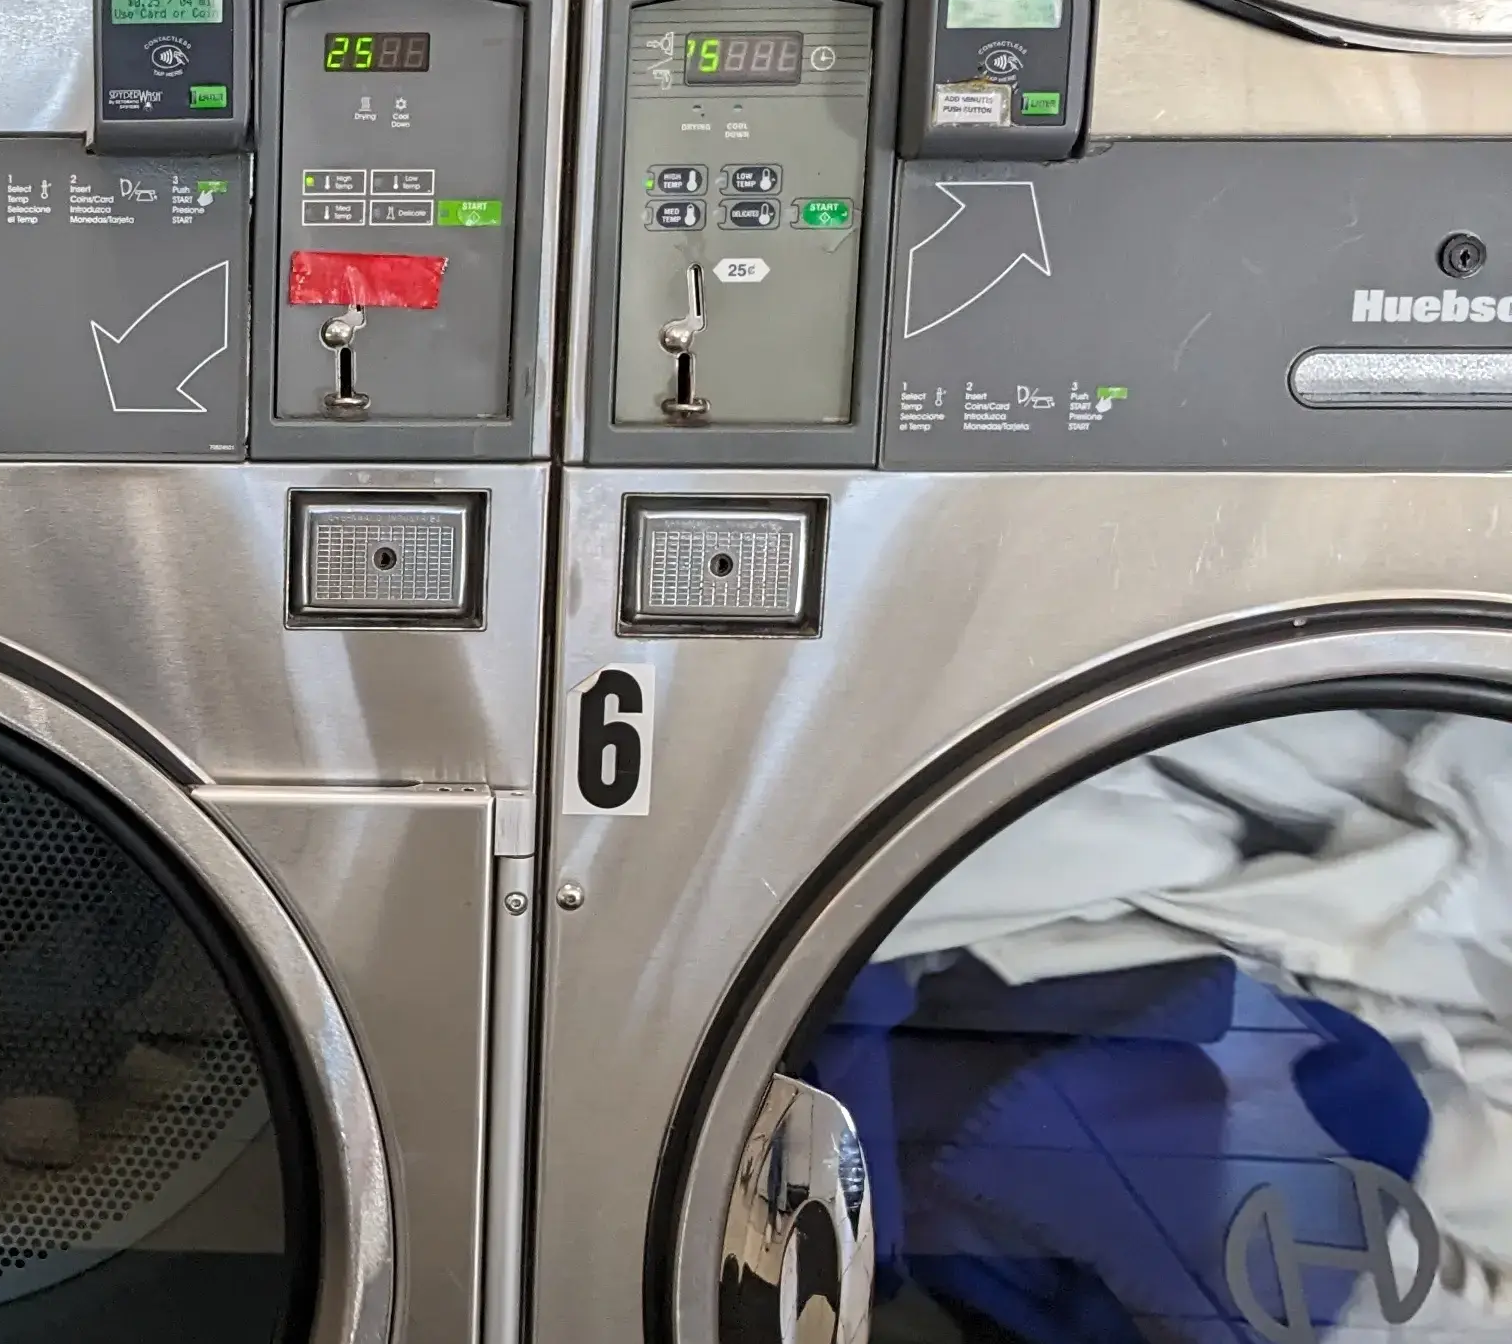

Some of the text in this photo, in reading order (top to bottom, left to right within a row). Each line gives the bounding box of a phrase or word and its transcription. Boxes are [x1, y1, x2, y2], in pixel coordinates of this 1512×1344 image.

[114, 9, 134, 19] Use
[140, 8, 167, 18] Card
[173, 10, 185, 18] or
[144, 36, 192, 50] CONTACTLESS
[978, 40, 1028, 55] CONTACTLESS
[326, 37, 373, 68] 25
[354, 113, 377, 121] Drying
[681, 123, 711, 131] DRYING
[726, 122, 748, 130] COOL
[336, 174, 352, 183] High
[8, 185, 32, 193] Select
[70, 185, 92, 193] Insert
[172, 186, 190, 194] Push
[335, 182, 354, 191] Temp
[402, 182, 420, 190] Temp
[8, 196, 30, 204] Temp
[70, 196, 115, 204] Coins/Card
[172, 196, 193, 204] START
[7, 206, 52, 214] Seleccione
[70, 206, 112, 214] Introduzca
[172, 206, 205, 214] Presione
[462, 202, 488, 210] START
[809, 203, 838, 212] START
[334, 212, 352, 220] Temp
[398, 209, 426, 217] Delicate
[664, 208, 680, 216] MED
[17, 216, 38, 225] Temp
[70, 216, 135, 224] Monedas/Tarjeta
[172, 216, 193, 224] START
[728, 264, 756, 277] 25¢
[901, 392, 926, 400] Select
[965, 392, 988, 400] Insert
[901, 402, 922, 411] Temp
[964, 402, 1010, 410] Coins/Card
[900, 413, 945, 421] Seleccione
[1069, 413, 1102, 421] Presione
[908, 423, 931, 432] Temp
[963, 423, 1030, 432] Monedas/Tarjeta
[577, 669, 643, 809] 6
